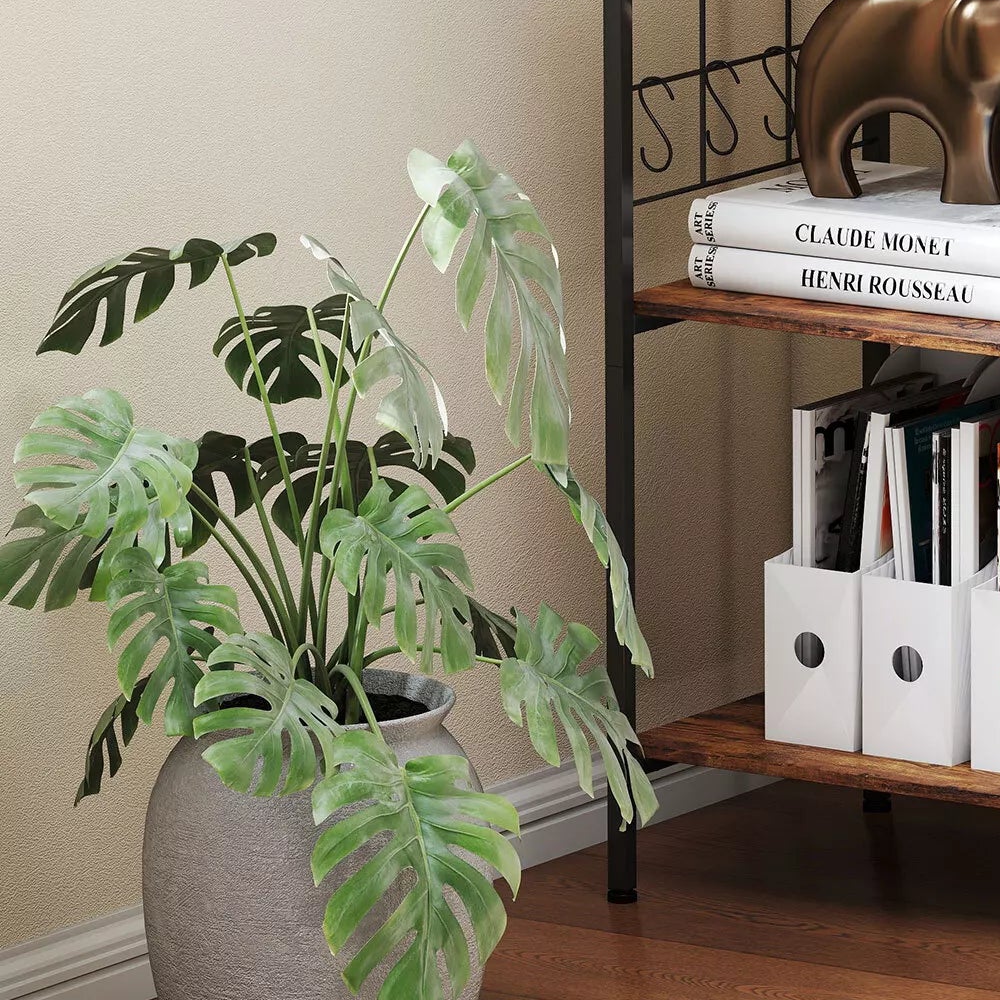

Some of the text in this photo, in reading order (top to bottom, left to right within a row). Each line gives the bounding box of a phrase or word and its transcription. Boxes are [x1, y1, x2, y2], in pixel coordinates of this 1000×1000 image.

[693, 211, 704, 235] ART
[704, 200, 719, 243] SERIES
[795, 223, 955, 257] CLAUDE MONET
[693, 256, 704, 280] ART
[704, 245, 719, 288] SERIES
[801, 268, 975, 304] HENRI ROUSSEAU
